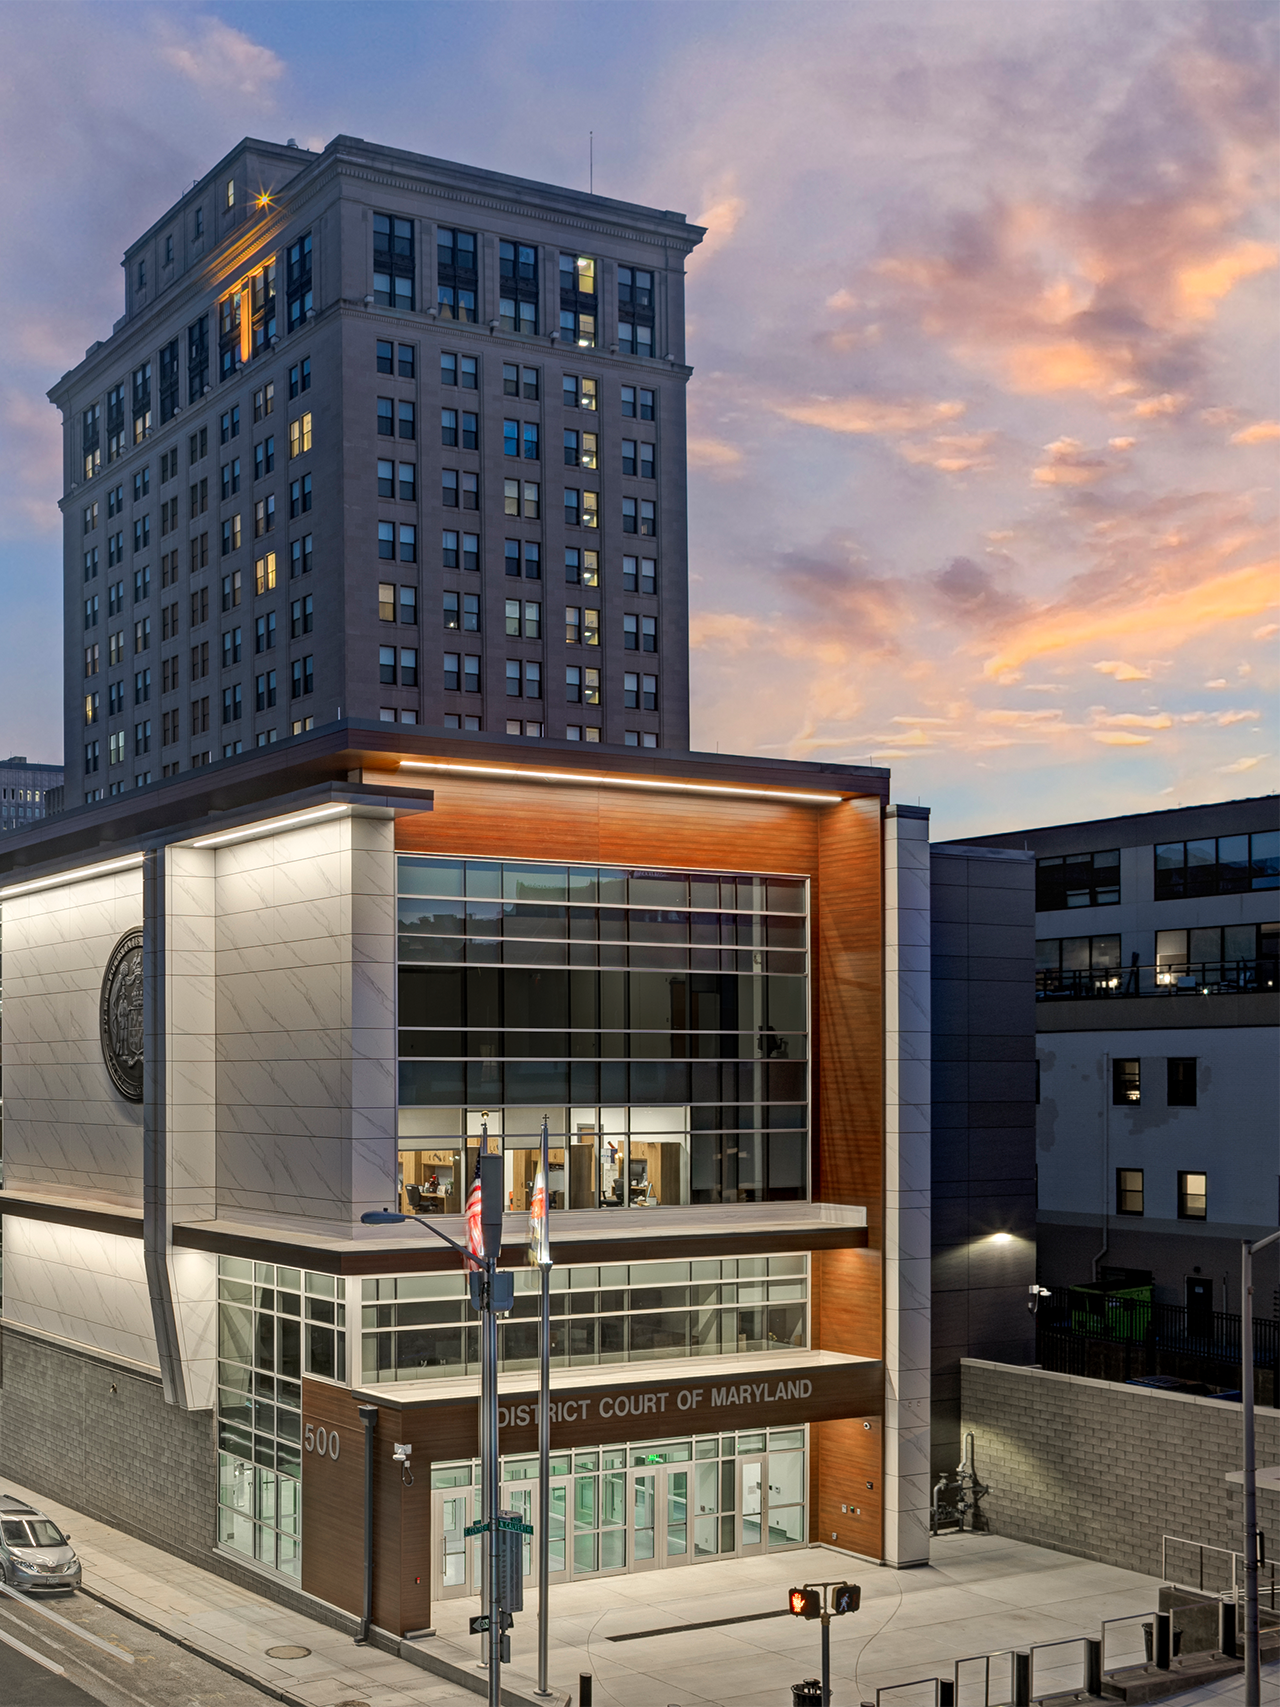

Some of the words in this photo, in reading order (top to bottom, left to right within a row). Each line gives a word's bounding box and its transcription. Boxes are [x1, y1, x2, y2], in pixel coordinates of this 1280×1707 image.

[498, 1399, 591, 1428] DISTRICT
[599, 1392, 669, 1418] COURT
[676, 1389, 704, 1411] OF
[711, 1379, 813, 1408] MARYLAND
[304, 1423, 340, 1461] 500
[480, 1619, 489, 1628] ON
